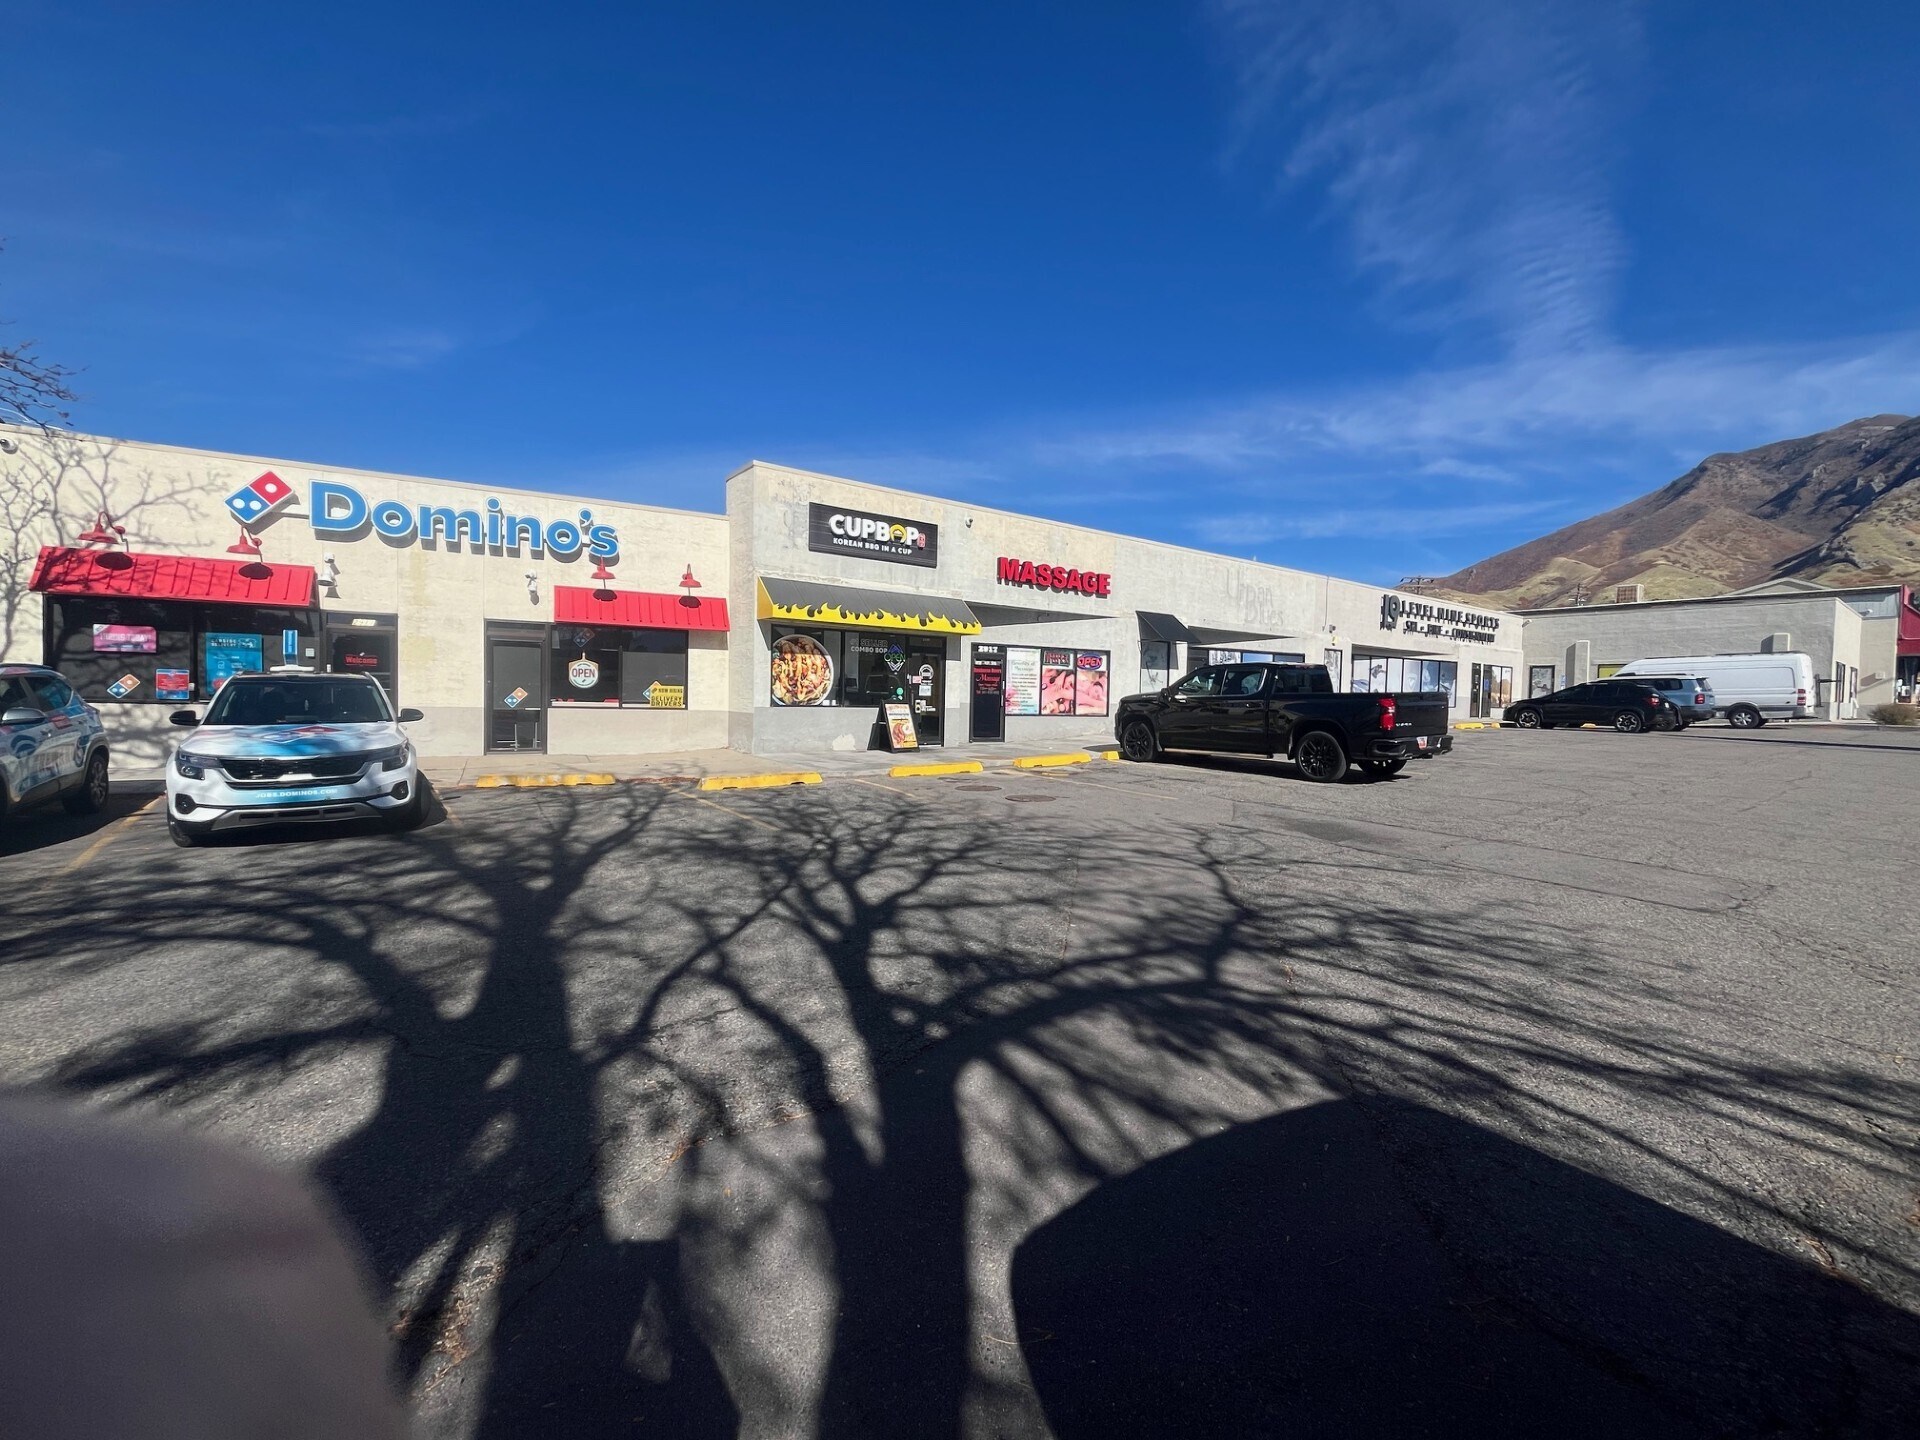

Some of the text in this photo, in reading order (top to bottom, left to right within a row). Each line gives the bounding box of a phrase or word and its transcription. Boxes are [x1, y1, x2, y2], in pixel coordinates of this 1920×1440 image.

[308, 479, 620, 558] Domino's
[828, 514, 919, 546] CUPBOP
[833, 537, 863, 548] KOREAN
[865, 541, 880, 551] BBQ
[881, 545, 890, 553] IN
[897, 547, 913, 556] CUP
[997, 556, 1111, 596] MASSAGE
[1401, 600, 1500, 630] LEVEL NINE SPORTS
[345, 655, 378, 665] Welcome
[884, 653, 906, 662] OPEN
[1077, 655, 1103, 667] OPEN
[571, 668, 596, 678] OPEN
